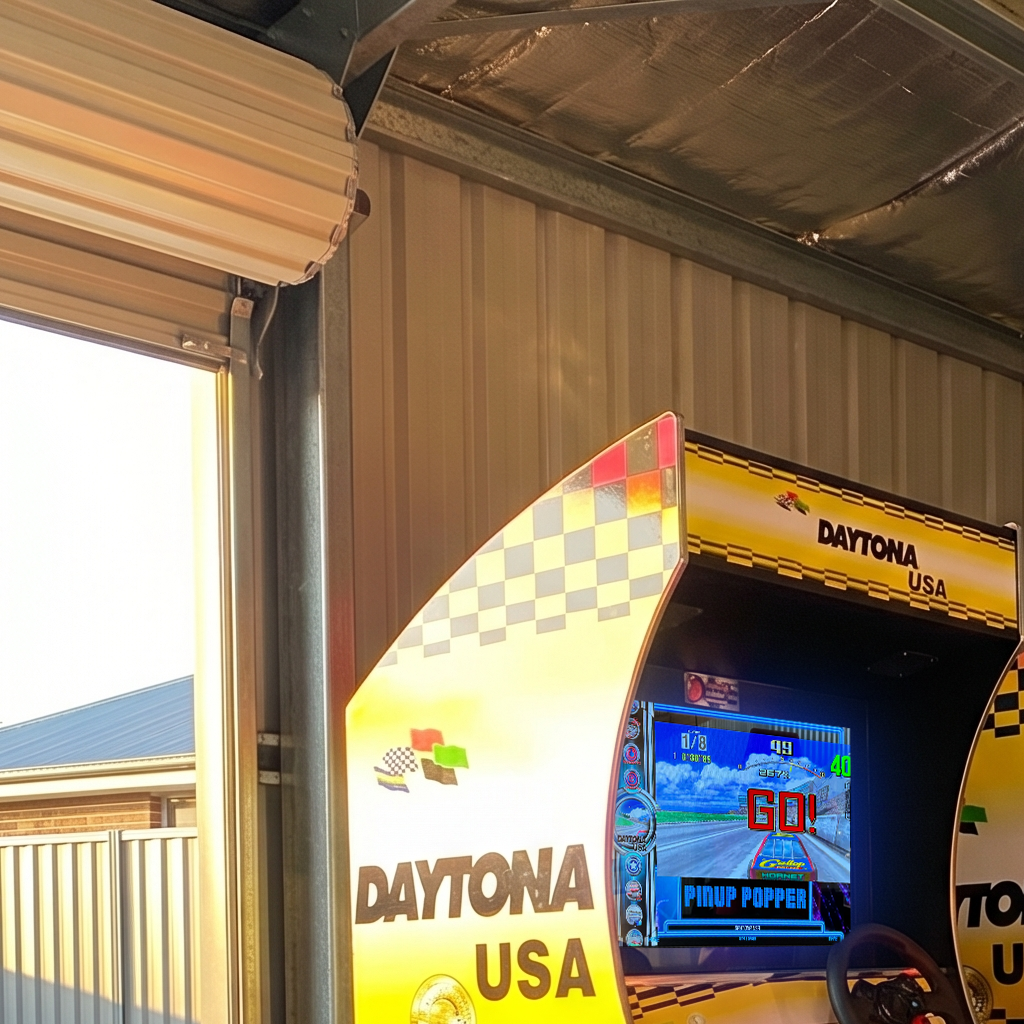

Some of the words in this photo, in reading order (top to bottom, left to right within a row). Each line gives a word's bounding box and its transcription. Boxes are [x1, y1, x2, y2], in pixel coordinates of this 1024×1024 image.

[818, 518, 918, 569] DAYTONA
[909, 570, 947, 599] USA
[681, 733, 707, 751] 1/8
[830, 754, 851, 777] 40
[747, 788, 817, 835] GO!
[355, 844, 595, 924] DAYTONA
[761, 872, 805, 880] HORNET
[684, 885, 737, 908] PINUP
[741, 886, 807, 909] POPPER
[475, 938, 596, 1001] USA
